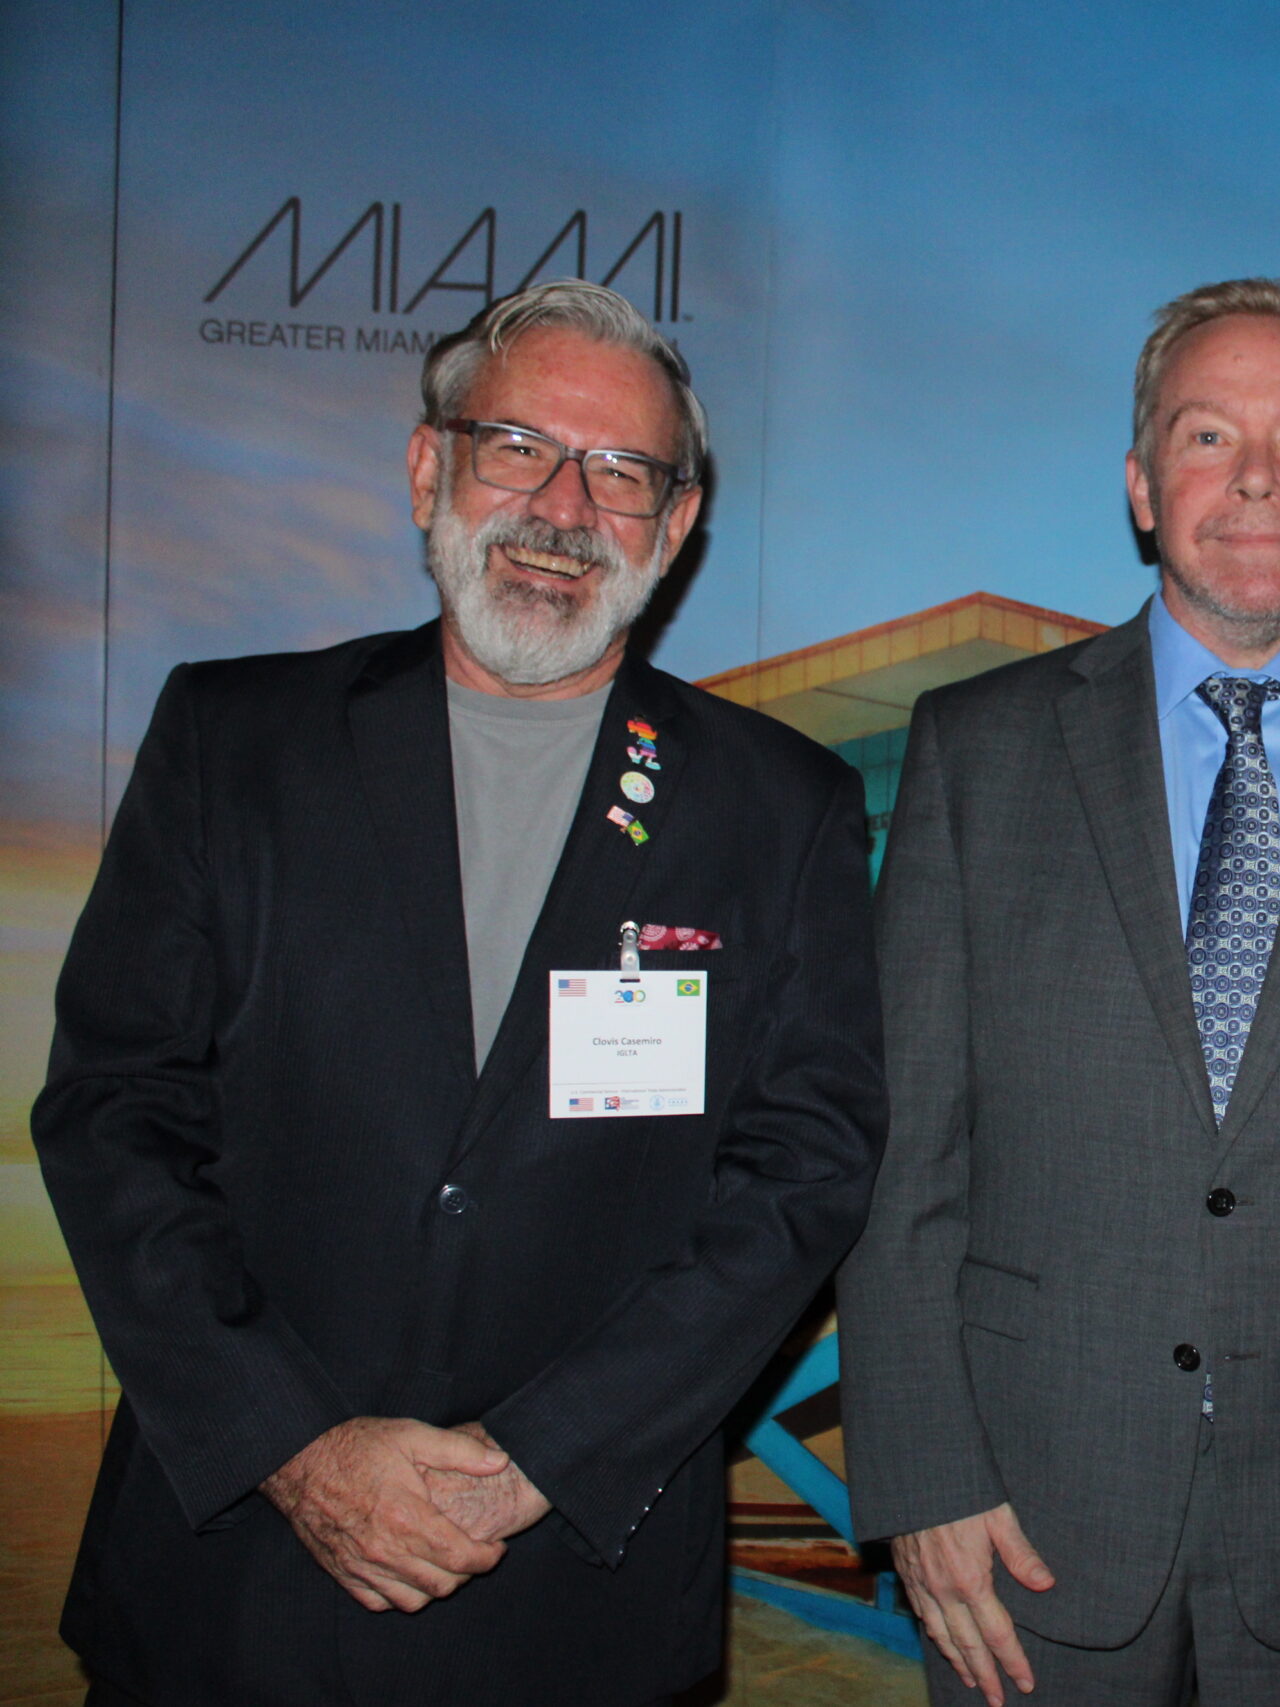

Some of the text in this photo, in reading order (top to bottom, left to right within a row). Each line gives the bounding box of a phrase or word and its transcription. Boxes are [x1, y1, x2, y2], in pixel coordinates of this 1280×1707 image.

[199, 319, 441, 353] GREATER MIAM
[592, 1036, 662, 1046] Clovis Casemiro
